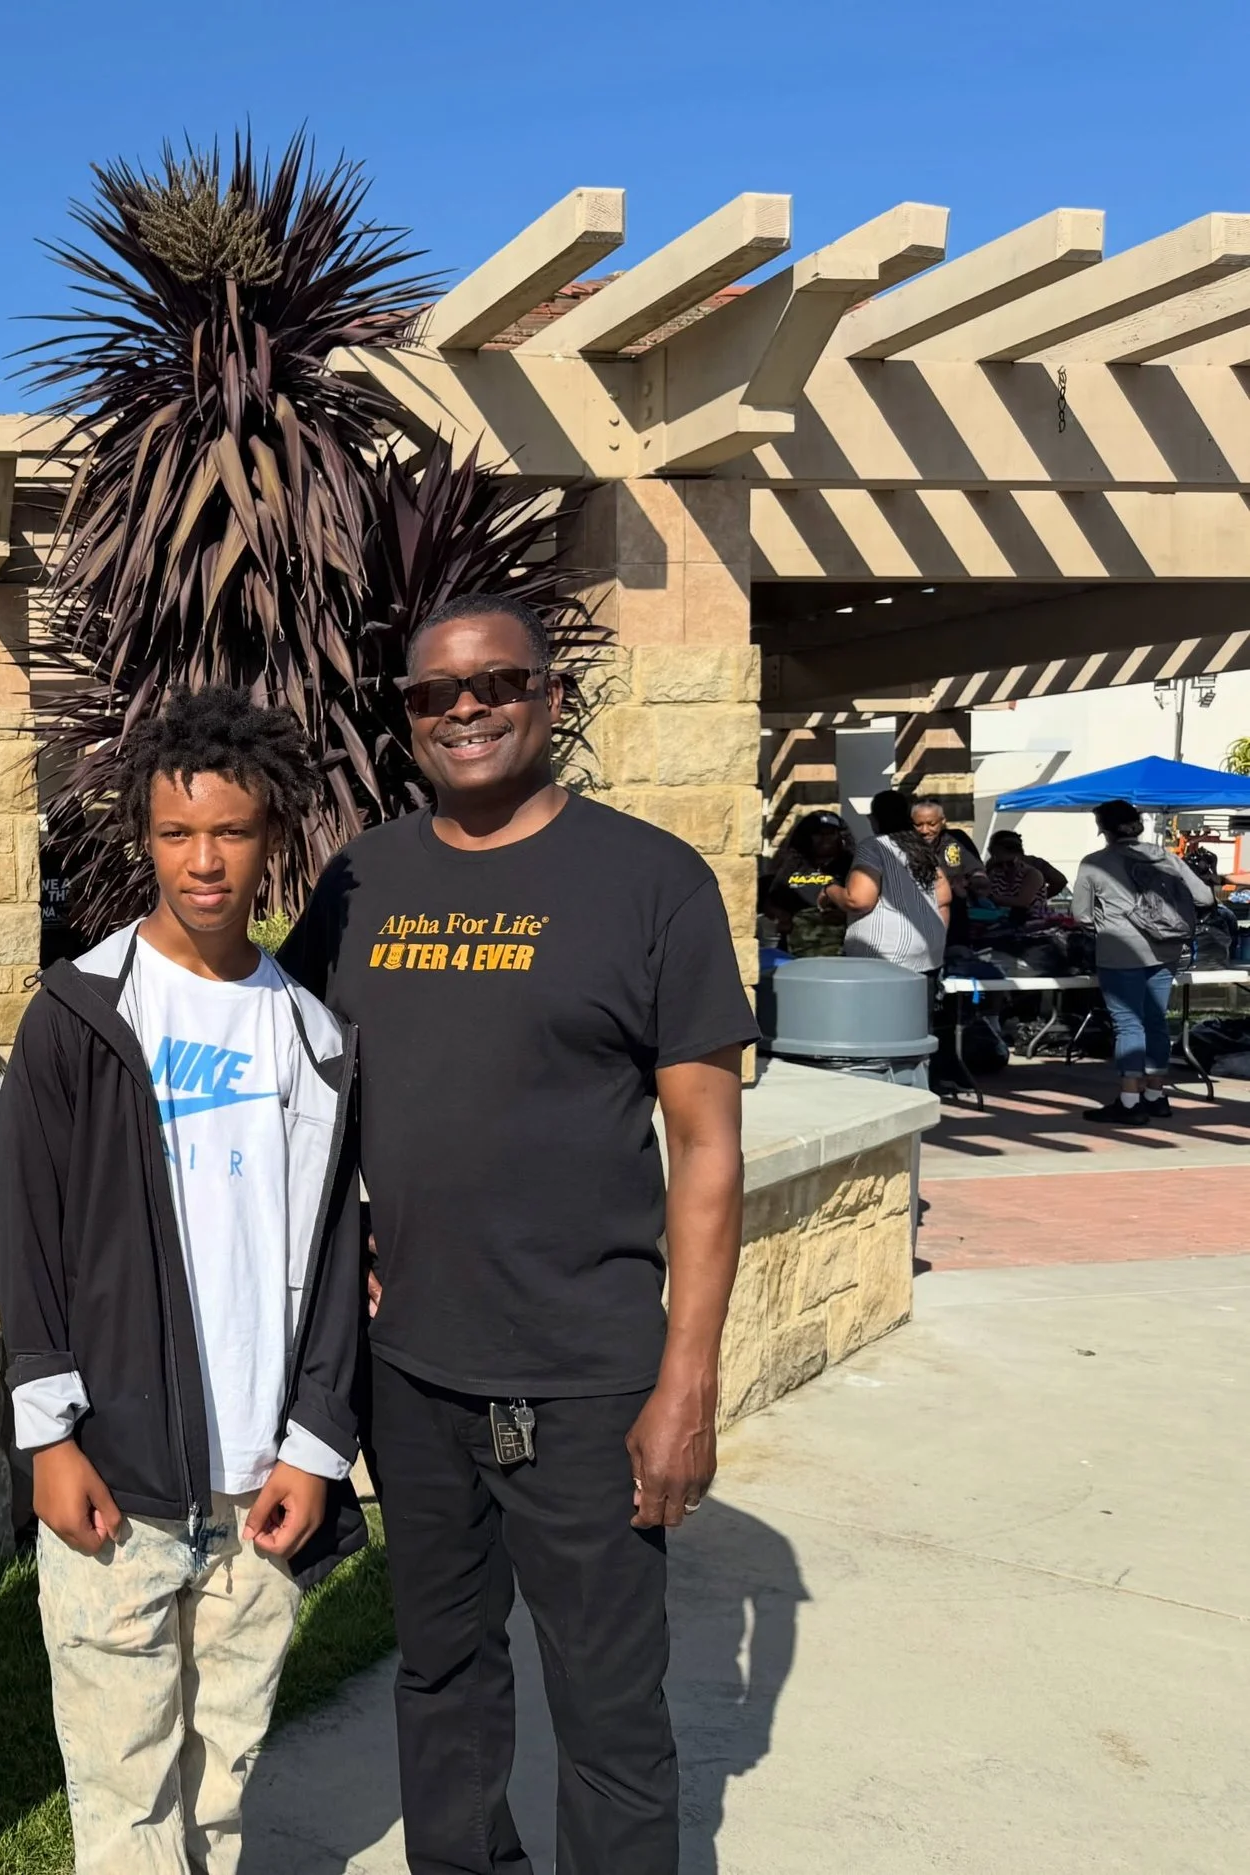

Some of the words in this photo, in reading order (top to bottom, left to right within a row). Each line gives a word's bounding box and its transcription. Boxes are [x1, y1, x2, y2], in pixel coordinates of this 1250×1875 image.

[788, 875, 833, 885] NAACP
[377, 913, 439, 940] Alpha
[444, 912, 489, 934] For
[451, 944, 470, 970] 4
[472, 943, 535, 971] EVER
[150, 1036, 253, 1095] NIKE
